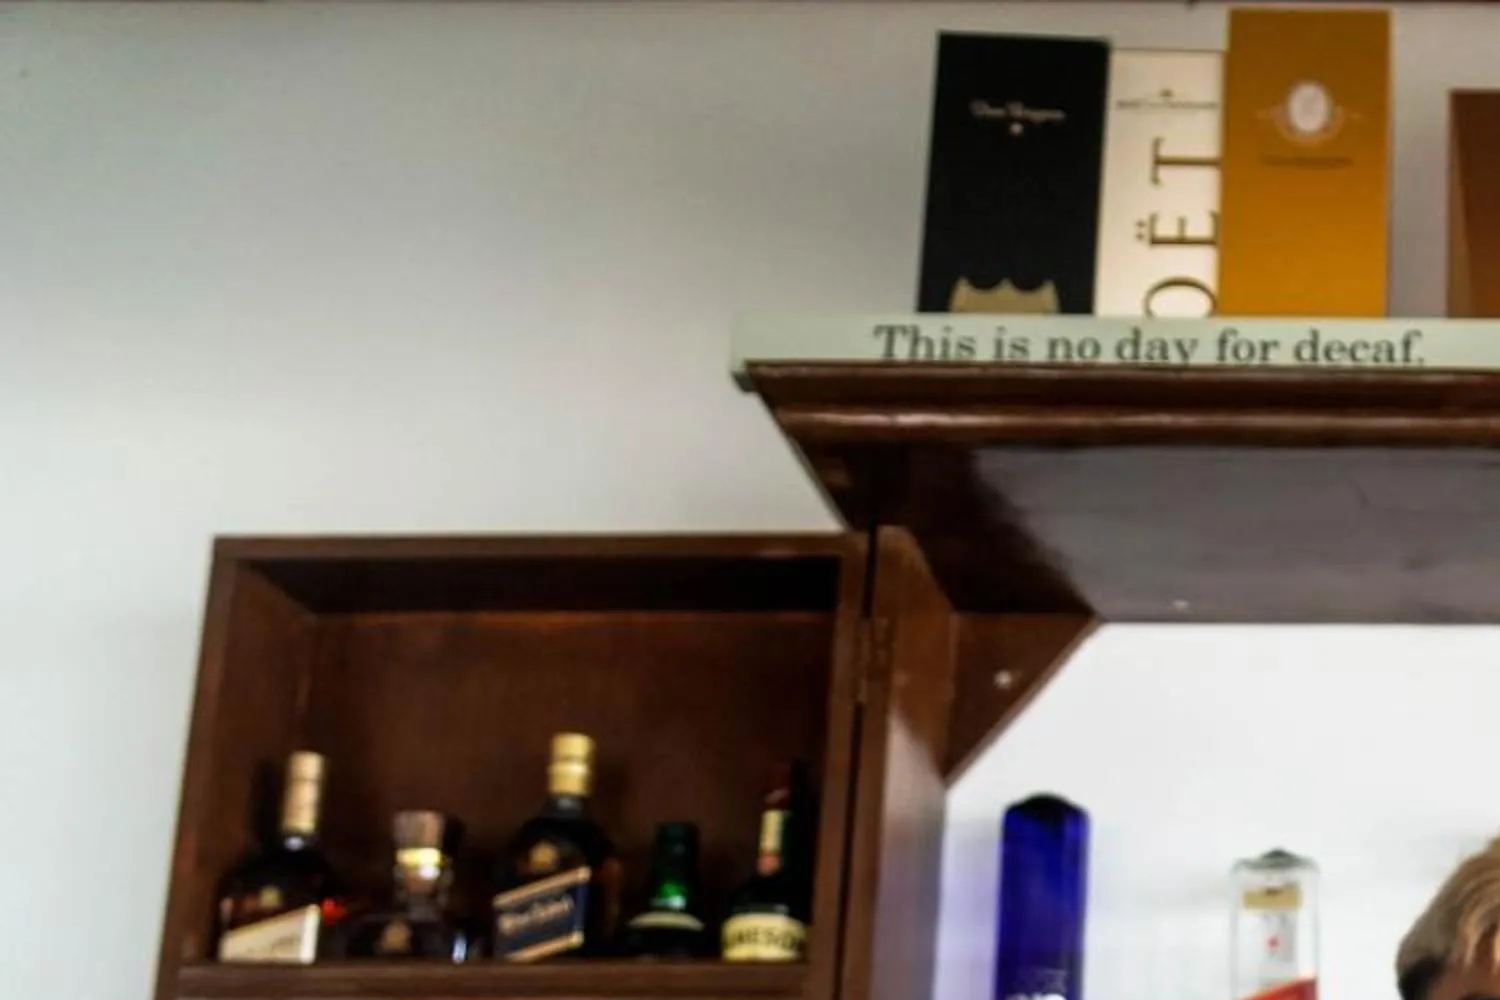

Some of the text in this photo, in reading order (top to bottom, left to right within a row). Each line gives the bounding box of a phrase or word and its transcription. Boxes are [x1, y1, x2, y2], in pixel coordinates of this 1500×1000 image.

[873, 324, 976, 361] This
[993, 325, 1030, 361] is
[1046, 335, 1101, 361] no
[1114, 325, 1198, 365] day
[1216, 326, 1280, 362] for
